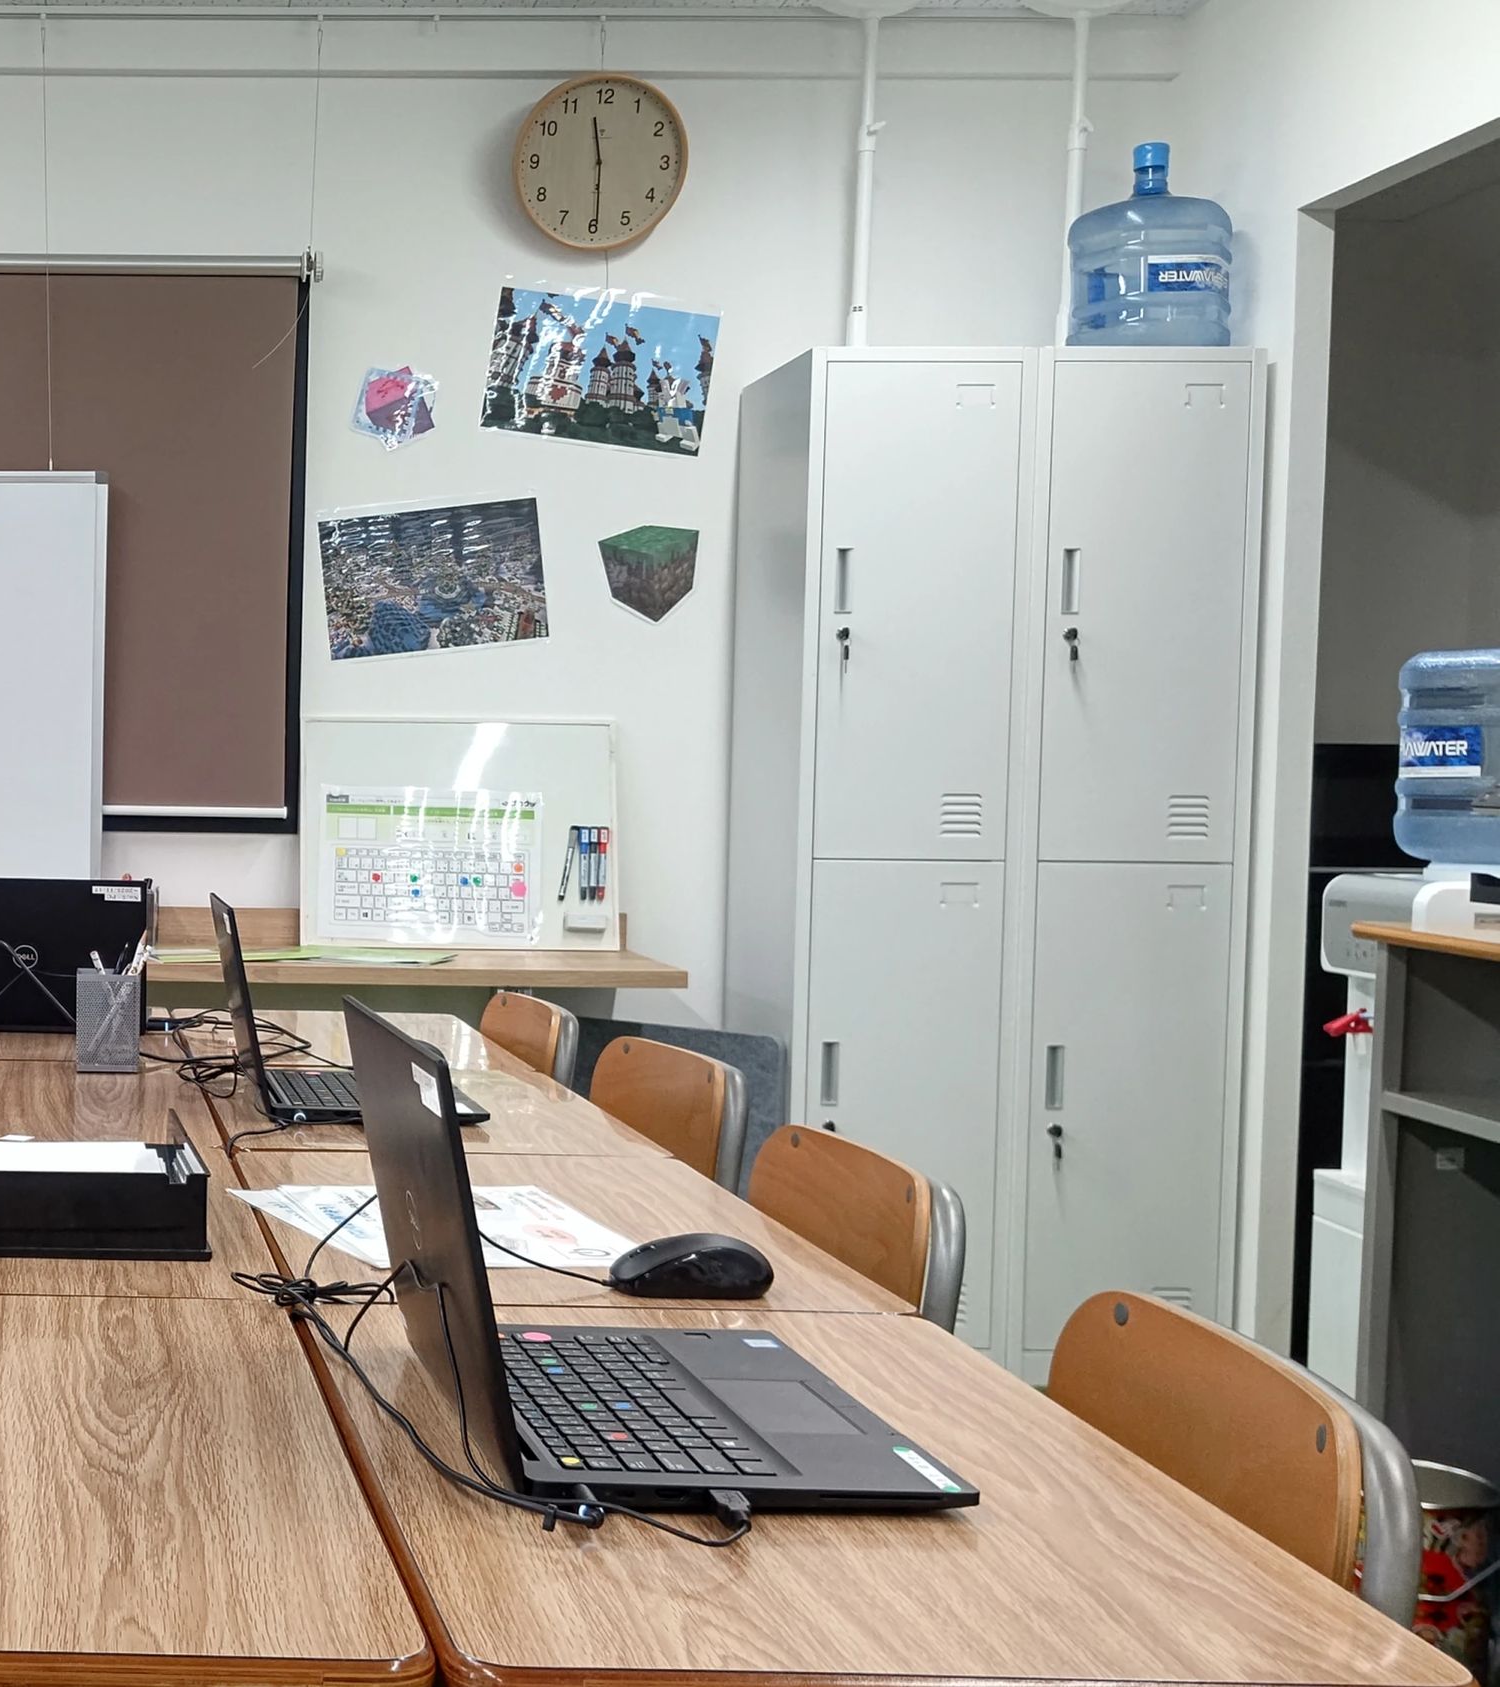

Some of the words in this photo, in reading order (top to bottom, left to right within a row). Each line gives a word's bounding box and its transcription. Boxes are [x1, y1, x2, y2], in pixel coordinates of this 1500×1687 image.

[595, 88, 615, 104] 12
[561, 98, 578, 114] 11
[633, 98, 641, 114] 1
[539, 120, 558, 136] 10
[653, 121, 665, 137] 2
[529, 153, 540, 169] 9
[659, 155, 670, 170] 3
[536, 186, 547, 202] 8
[645, 187, 656, 203] 4
[558, 209, 570, 225] 7
[619, 210, 631, 226] 5
[587, 218, 598, 234] 6
